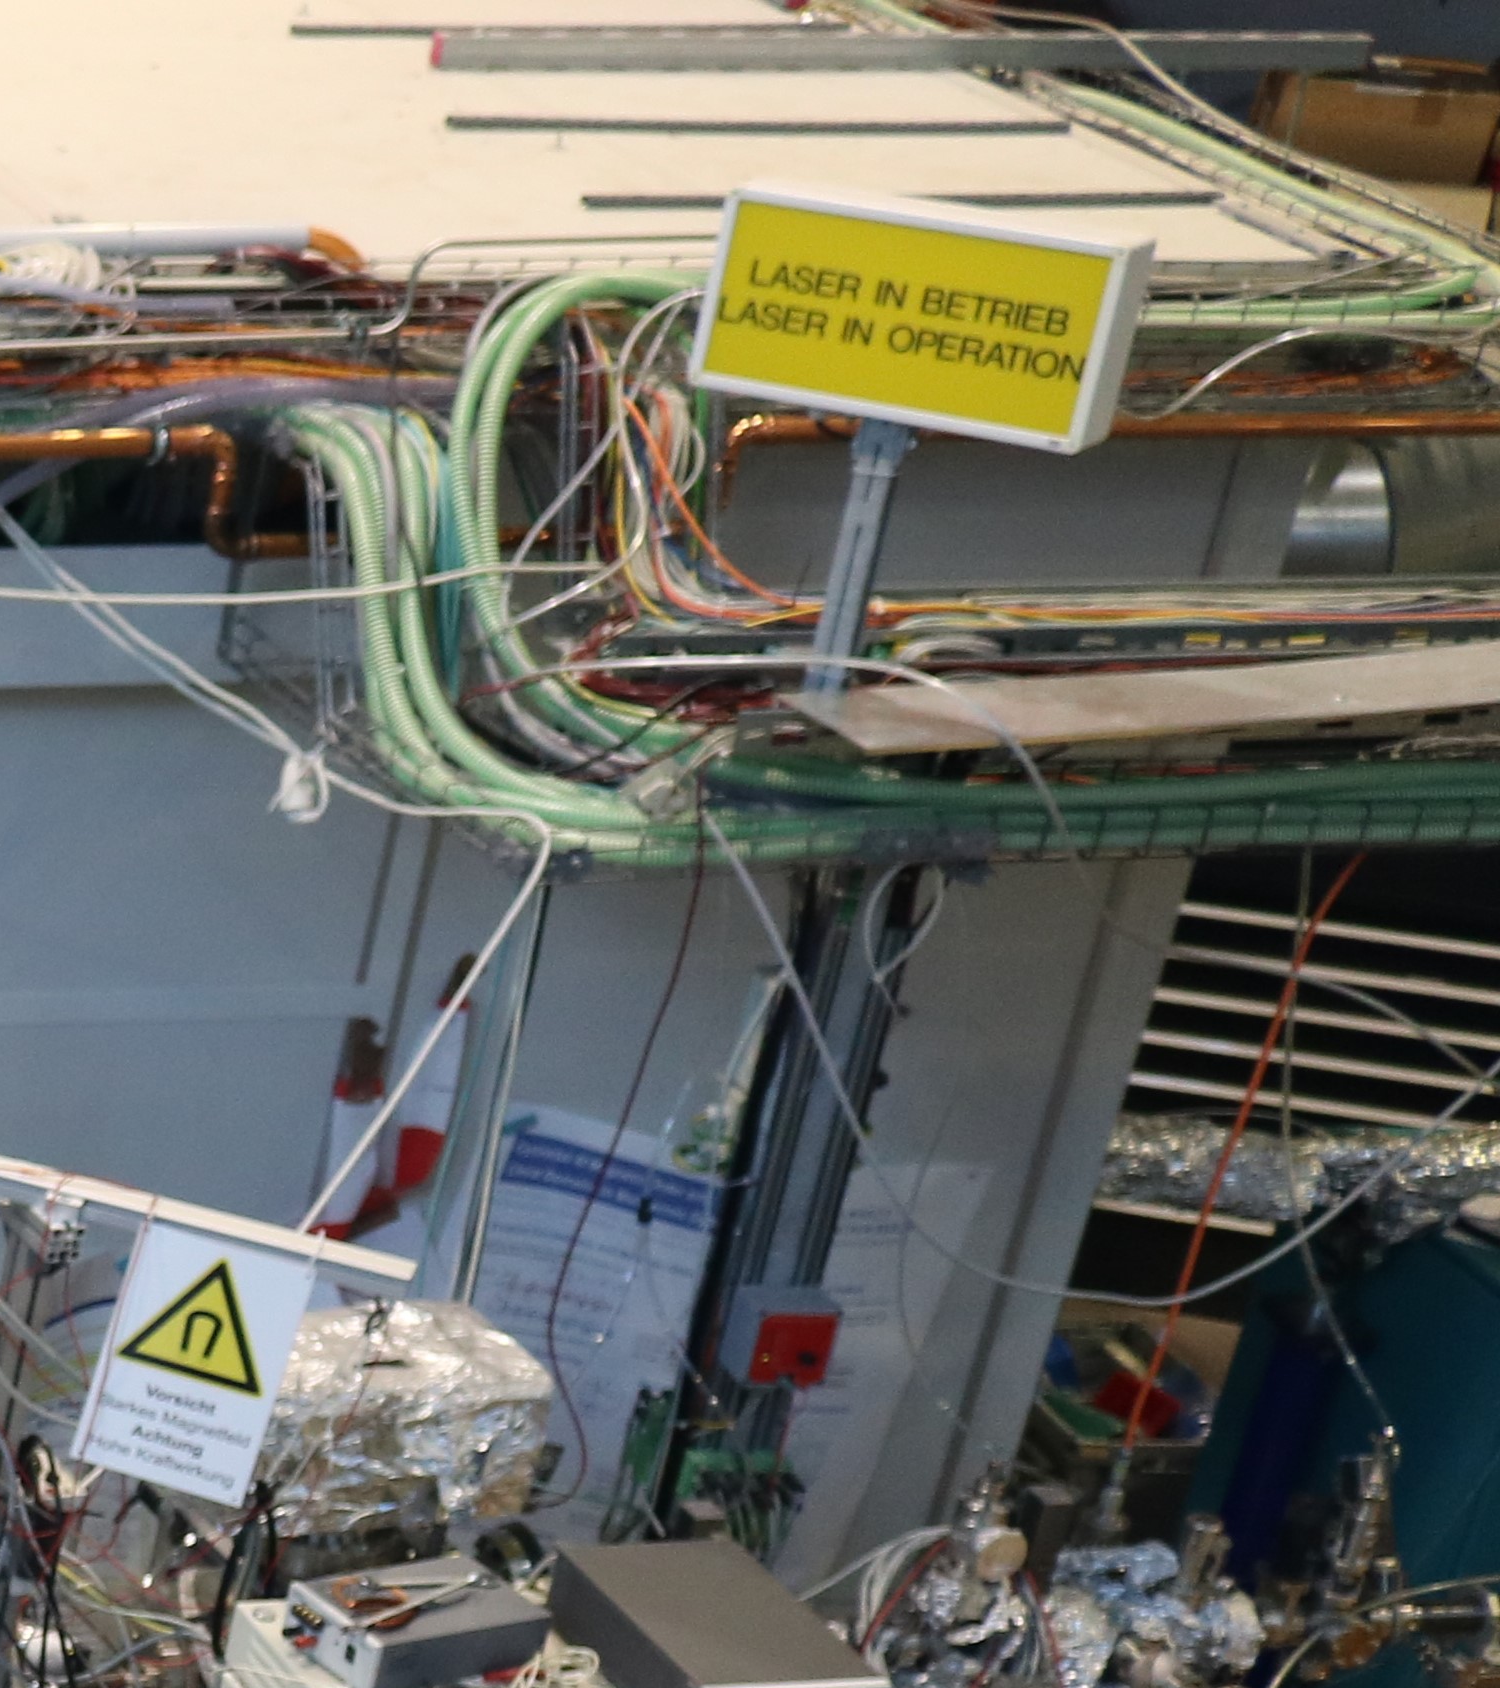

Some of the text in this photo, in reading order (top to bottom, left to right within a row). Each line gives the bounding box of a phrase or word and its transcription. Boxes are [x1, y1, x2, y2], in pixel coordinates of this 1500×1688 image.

[750, 258, 1070, 337] LASER IN BETRIEB
[717, 294, 1086, 385] LASER IN OPERATION
[145, 1382, 217, 1416] Vorsicht
[132, 1425, 204, 1459] Achtung
[163, 1411, 252, 1448] Magnetfeld
[136, 1447, 236, 1489] Kraftwirkung
